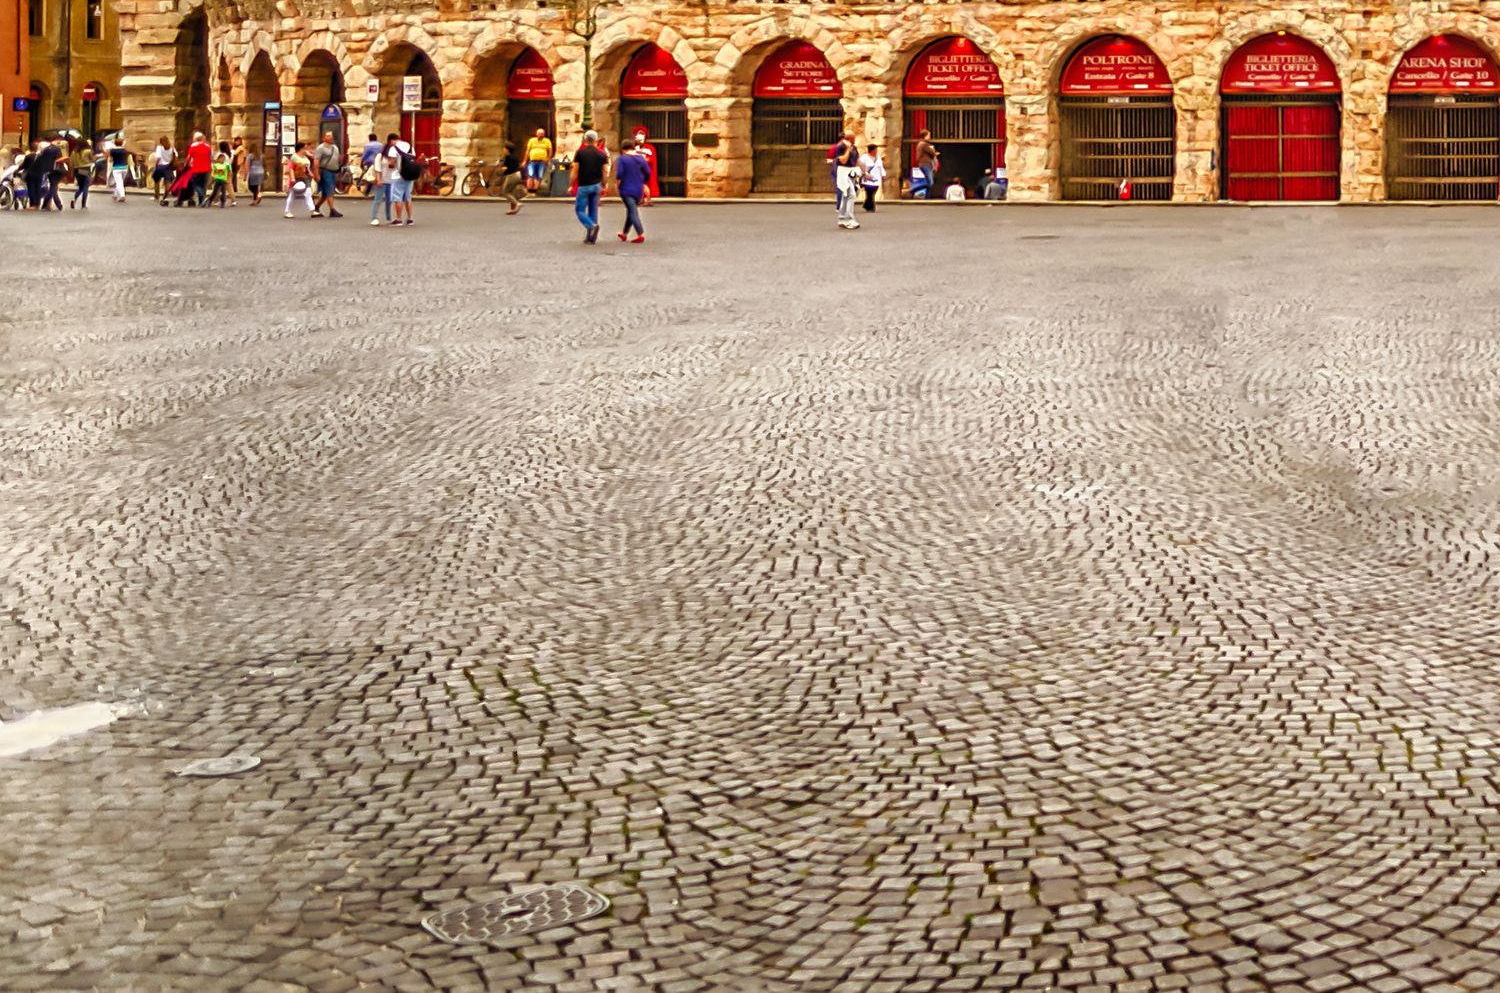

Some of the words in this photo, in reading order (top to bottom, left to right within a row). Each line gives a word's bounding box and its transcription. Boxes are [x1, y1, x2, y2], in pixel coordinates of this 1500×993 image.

[1083, 55, 1156, 65] POLTRONE
[1246, 54, 1317, 63] BIGLIETTERIA
[1399, 57, 1448, 68] ARENA
[1449, 57, 1487, 68] SHOP
[1245, 63, 1280, 72] TICKET
[1282, 63, 1319, 72] OFFICE
[1396, 71, 1440, 80] Cancello
[1449, 71, 1474, 80] Gate
[1475, 71, 1489, 80] 10
